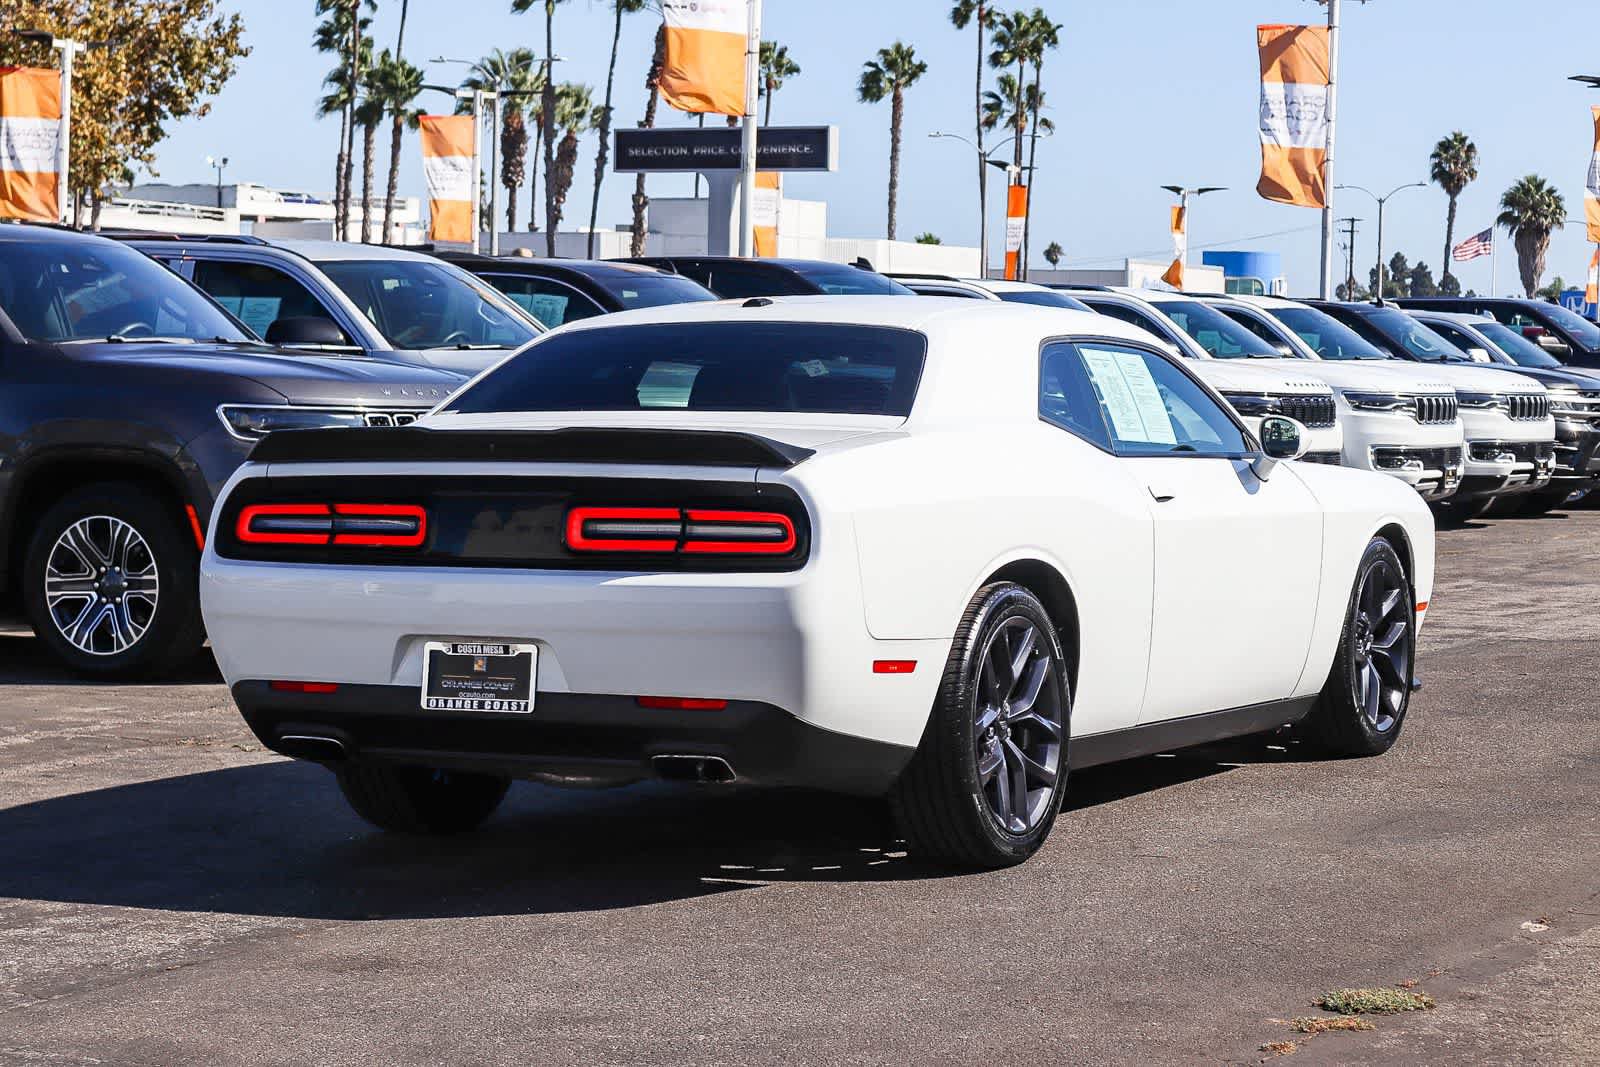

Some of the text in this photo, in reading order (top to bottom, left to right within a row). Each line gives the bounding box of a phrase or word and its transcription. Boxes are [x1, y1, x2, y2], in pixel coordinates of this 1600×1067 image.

[457, 644, 504, 655] COSTA MESA
[429, 698, 526, 711] ORANGE COAST
